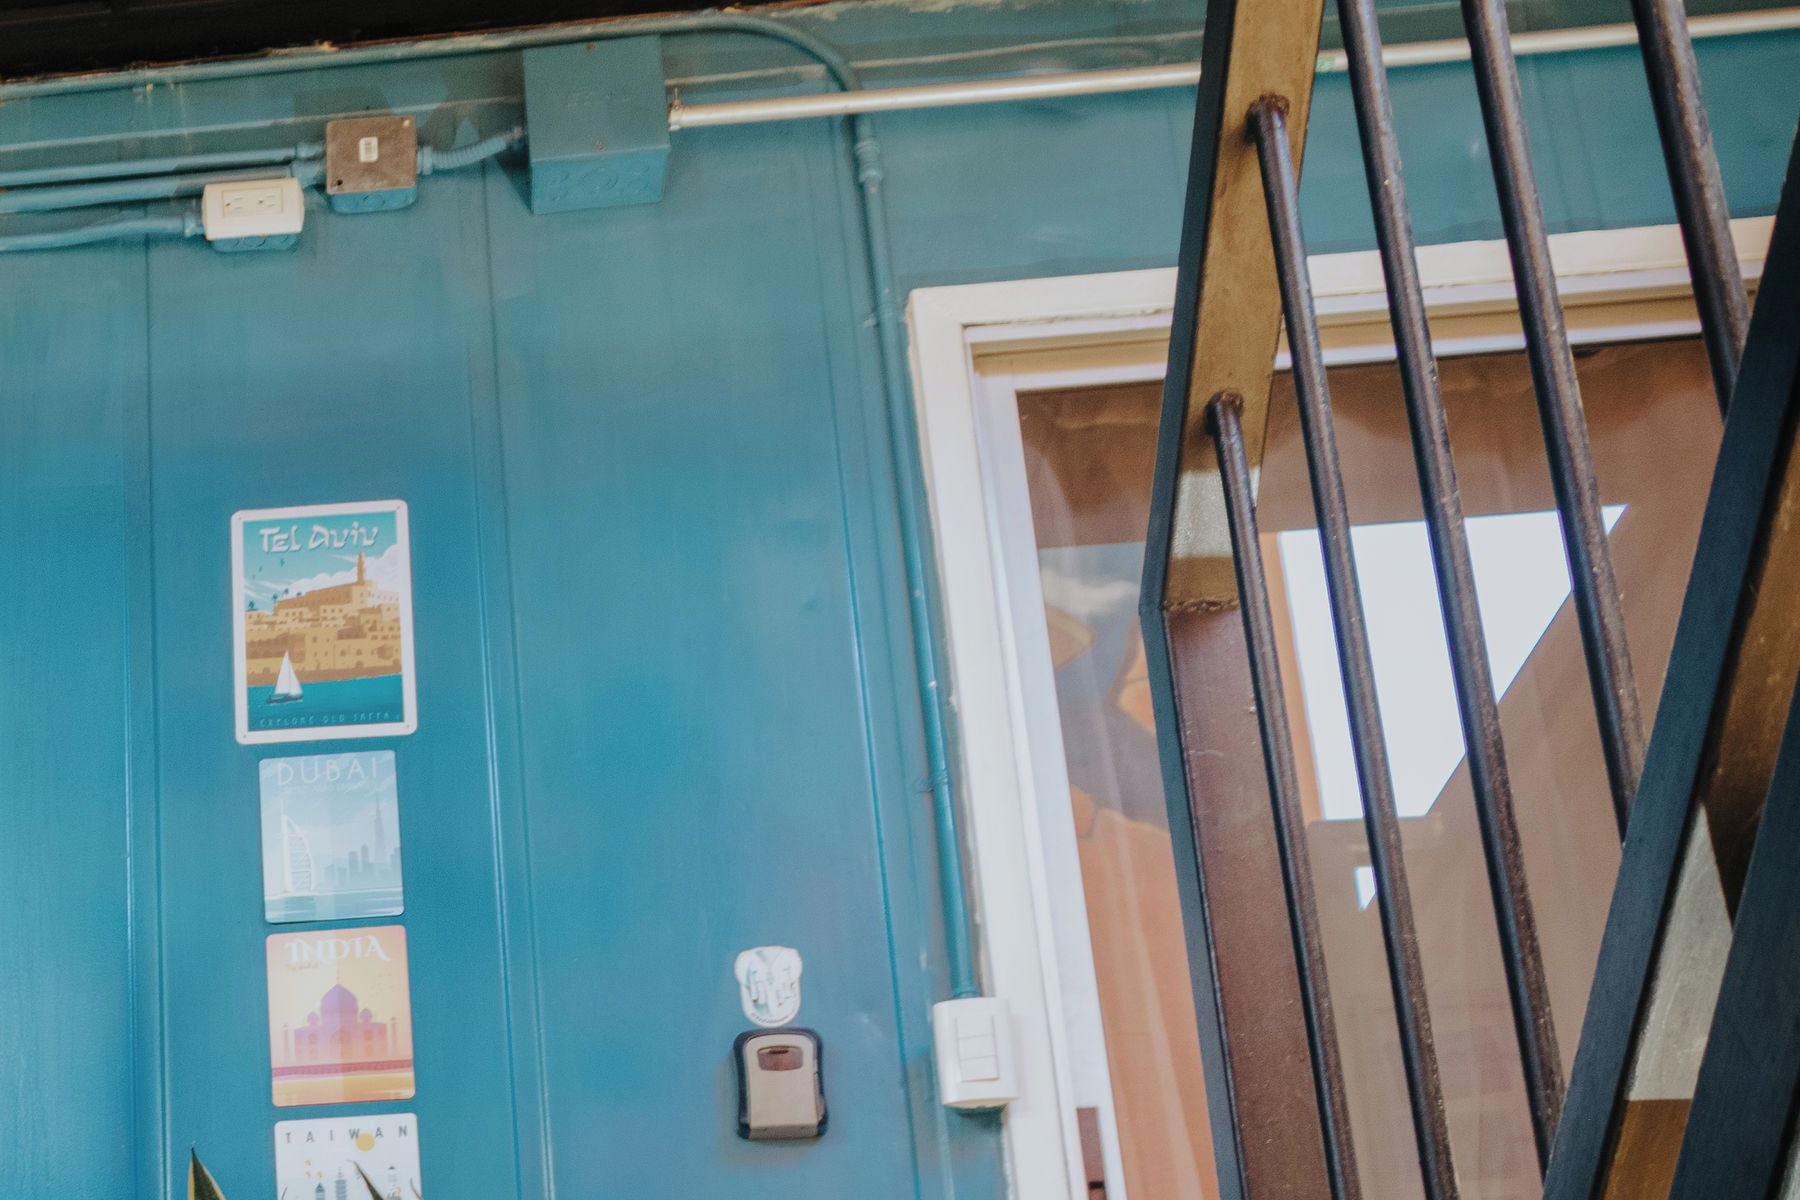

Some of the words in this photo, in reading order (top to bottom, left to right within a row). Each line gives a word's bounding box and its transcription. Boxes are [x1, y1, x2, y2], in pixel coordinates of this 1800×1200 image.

[278, 757, 377, 785] DUBAI
[284, 936, 391, 963] INDIA
[286, 1126, 408, 1144] TAIWAN
